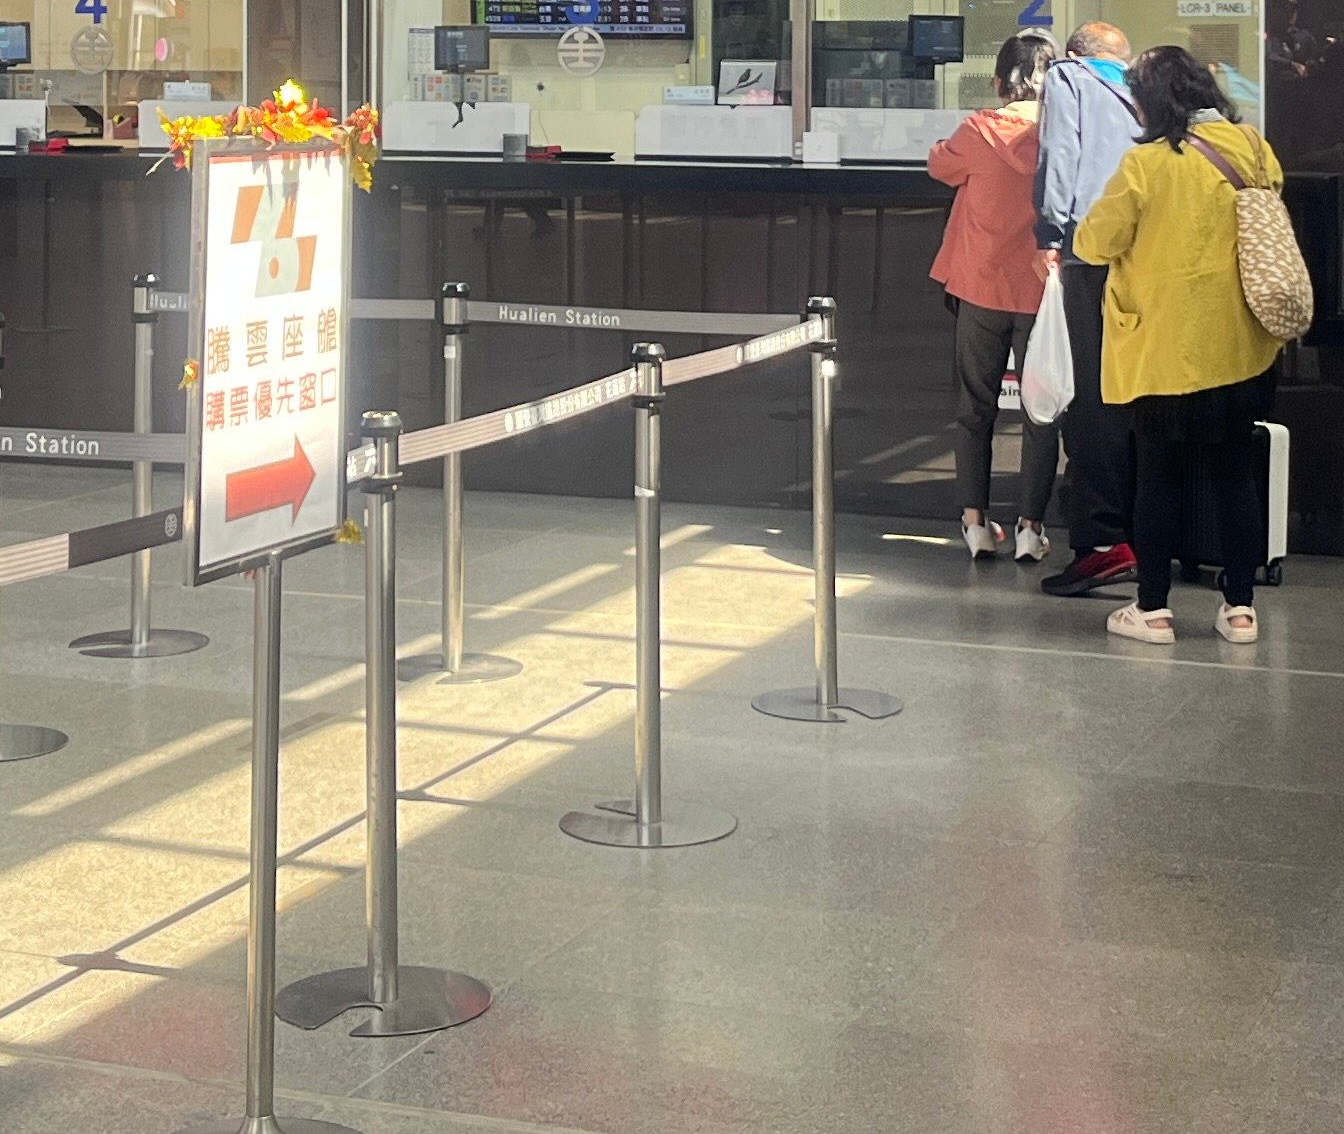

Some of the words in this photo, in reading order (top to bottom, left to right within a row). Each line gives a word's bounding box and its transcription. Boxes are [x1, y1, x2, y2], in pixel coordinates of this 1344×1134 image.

[1215, 2, 1247, 14] PANEL
[498, 305, 557, 325] Hualien
[565, 307, 621, 327] Station
[206, 367, 337, 432] 購票優先窗口
[26, 432, 100, 456] Station
